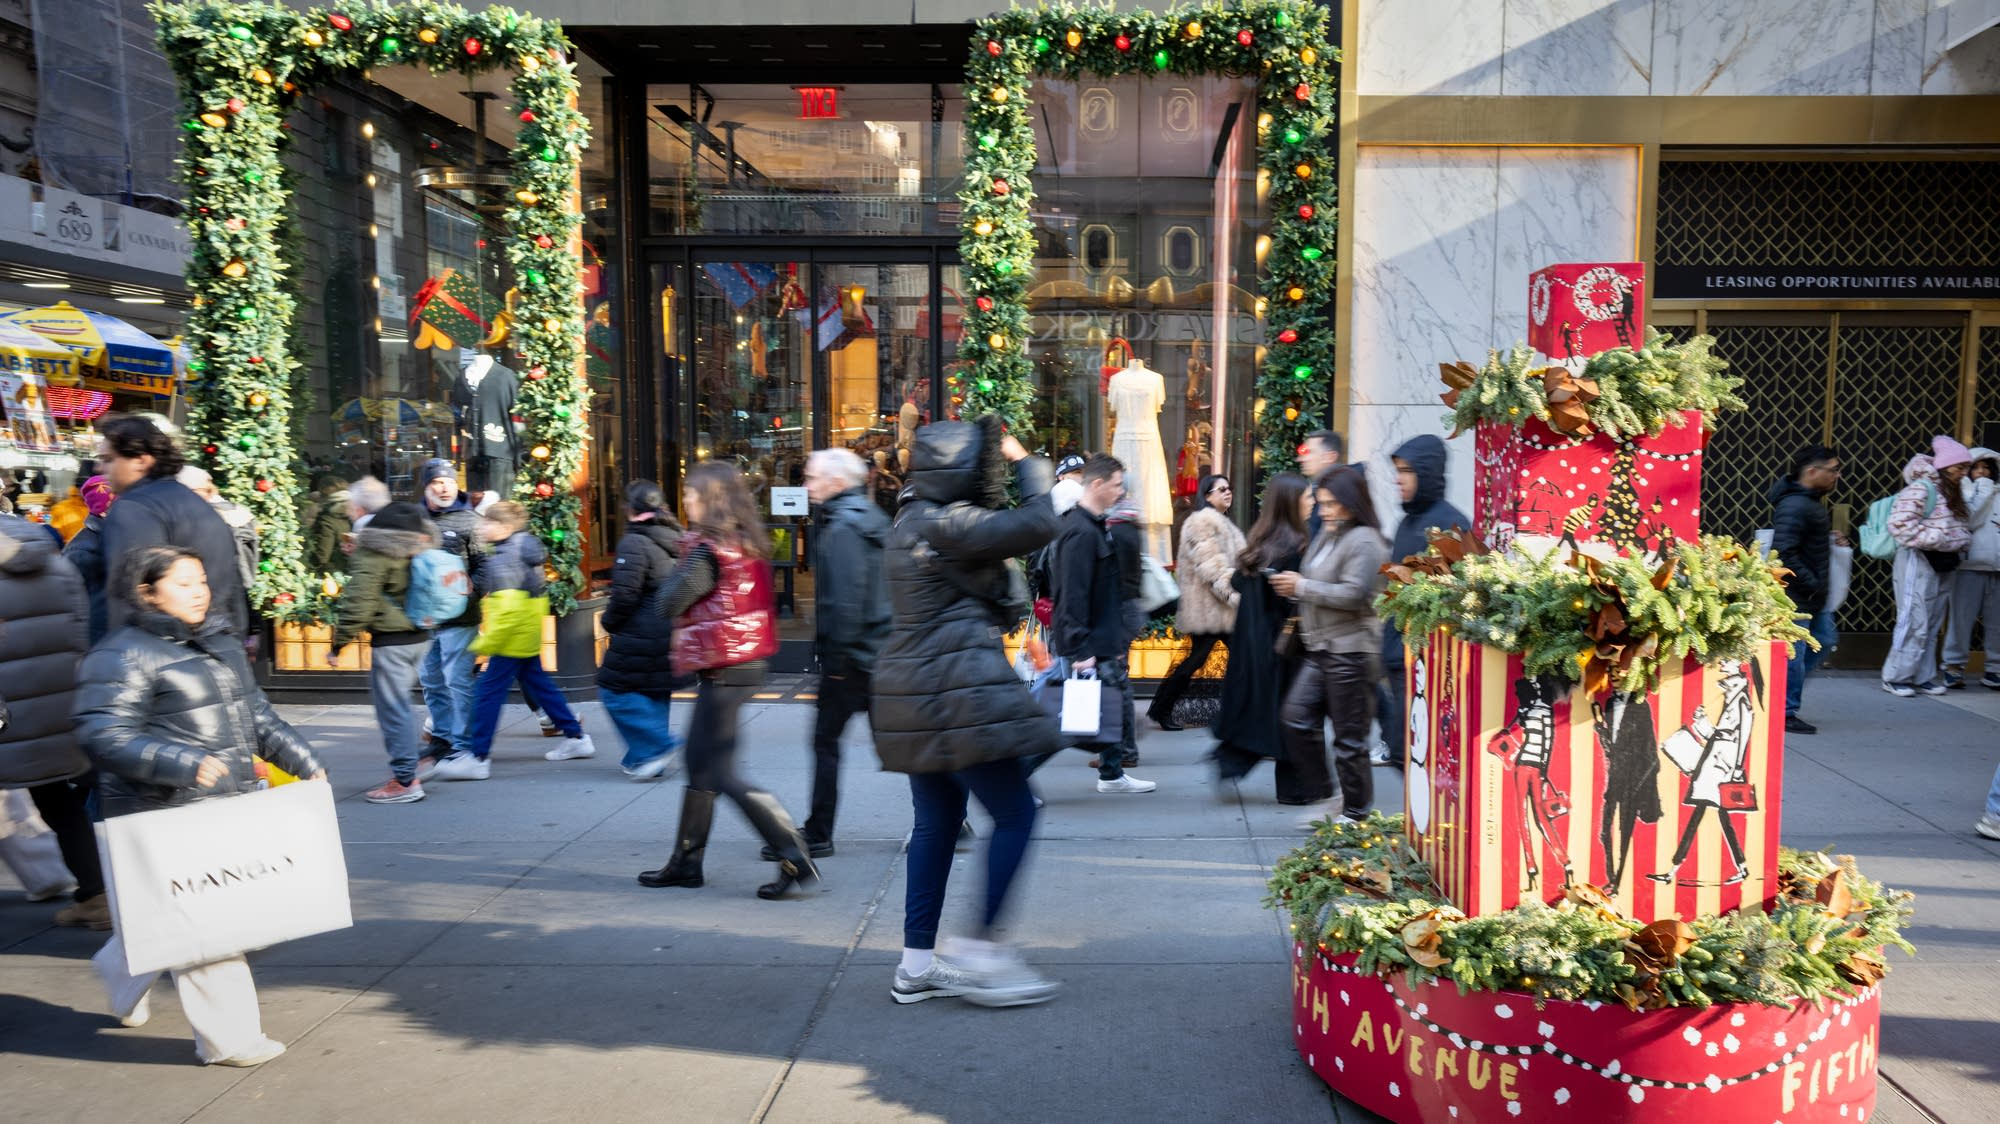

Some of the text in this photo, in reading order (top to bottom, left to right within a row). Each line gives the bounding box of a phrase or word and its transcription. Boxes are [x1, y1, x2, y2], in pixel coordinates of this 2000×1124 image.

[57, 217, 93, 242] 689
[1705, 276, 1776, 288] LEASING
[1781, 276, 1917, 289] OPPORTUNITIES
[80, 365, 170, 389] SABRETT
[1351, 1010, 1520, 1100] AVENUE
[1782, 1023, 1875, 1115] FIFTH
